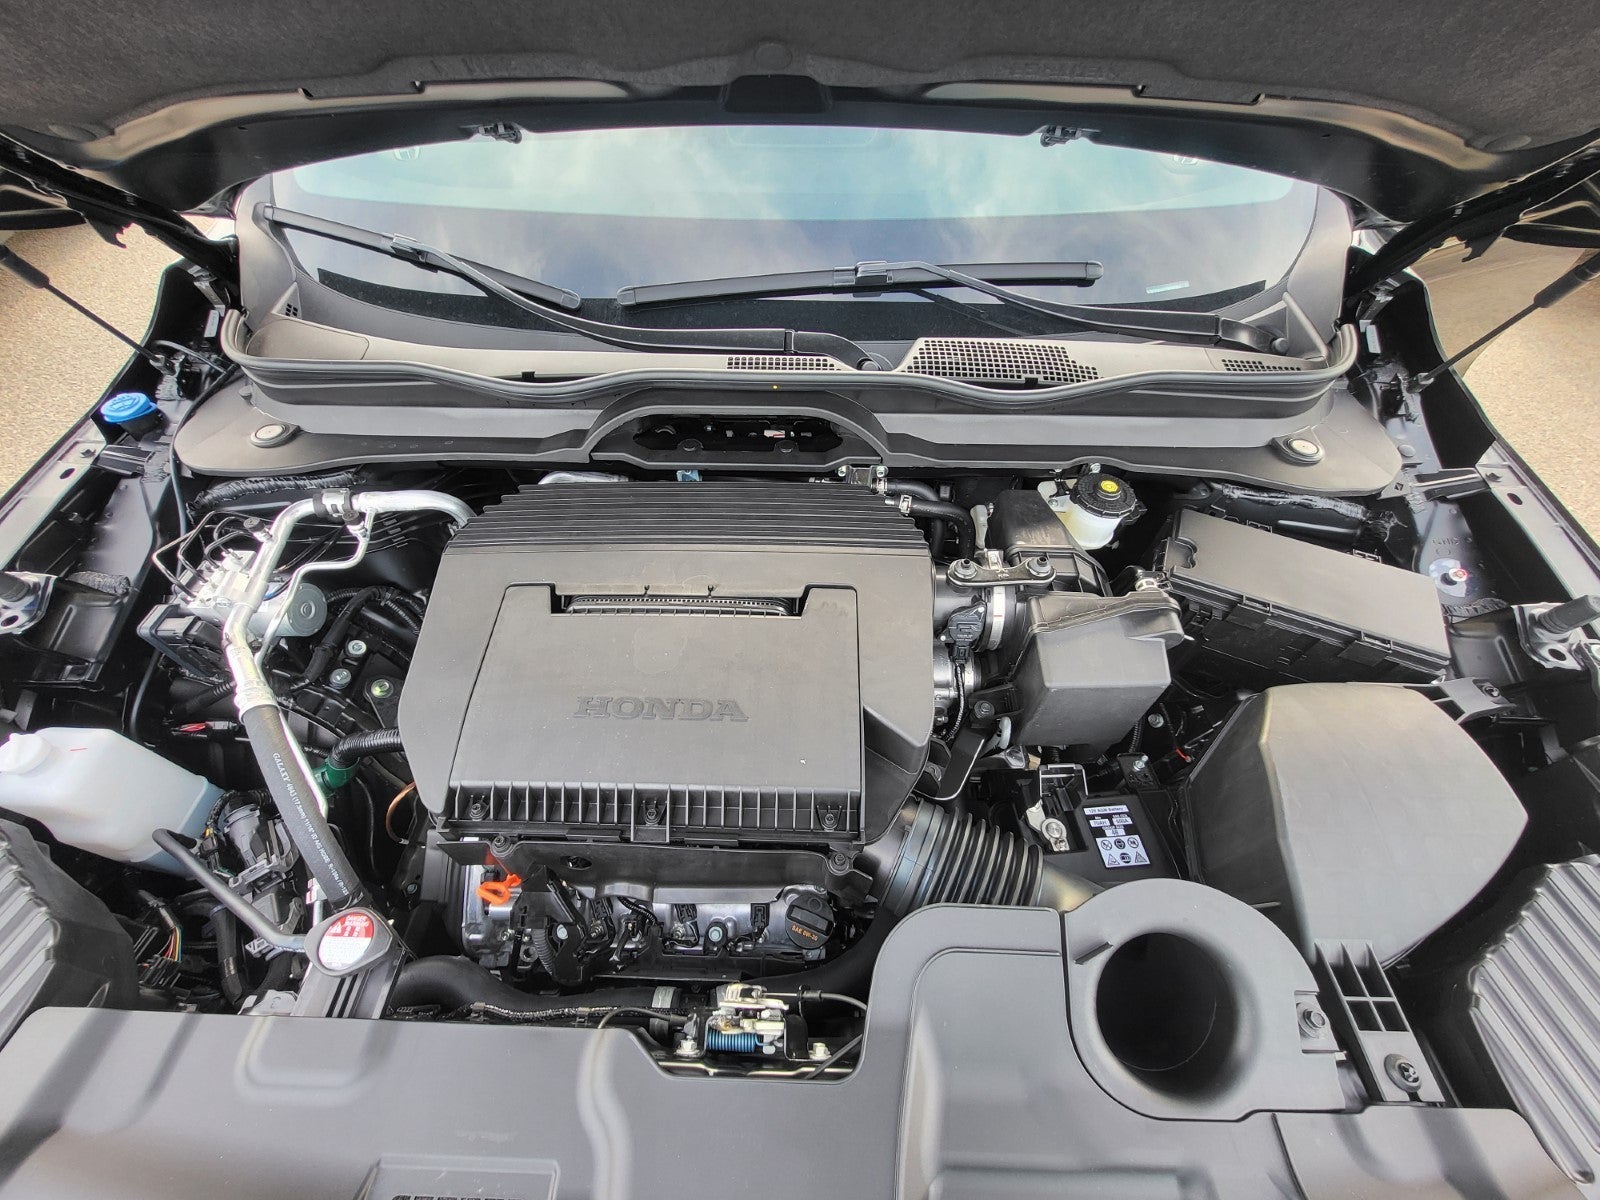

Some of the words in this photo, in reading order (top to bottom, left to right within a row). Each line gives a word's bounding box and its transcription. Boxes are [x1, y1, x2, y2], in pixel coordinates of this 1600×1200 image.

[572, 696, 750, 722] HONDA
[272, 752, 291, 782] GALAXY
[792, 925, 802, 934] SAE
